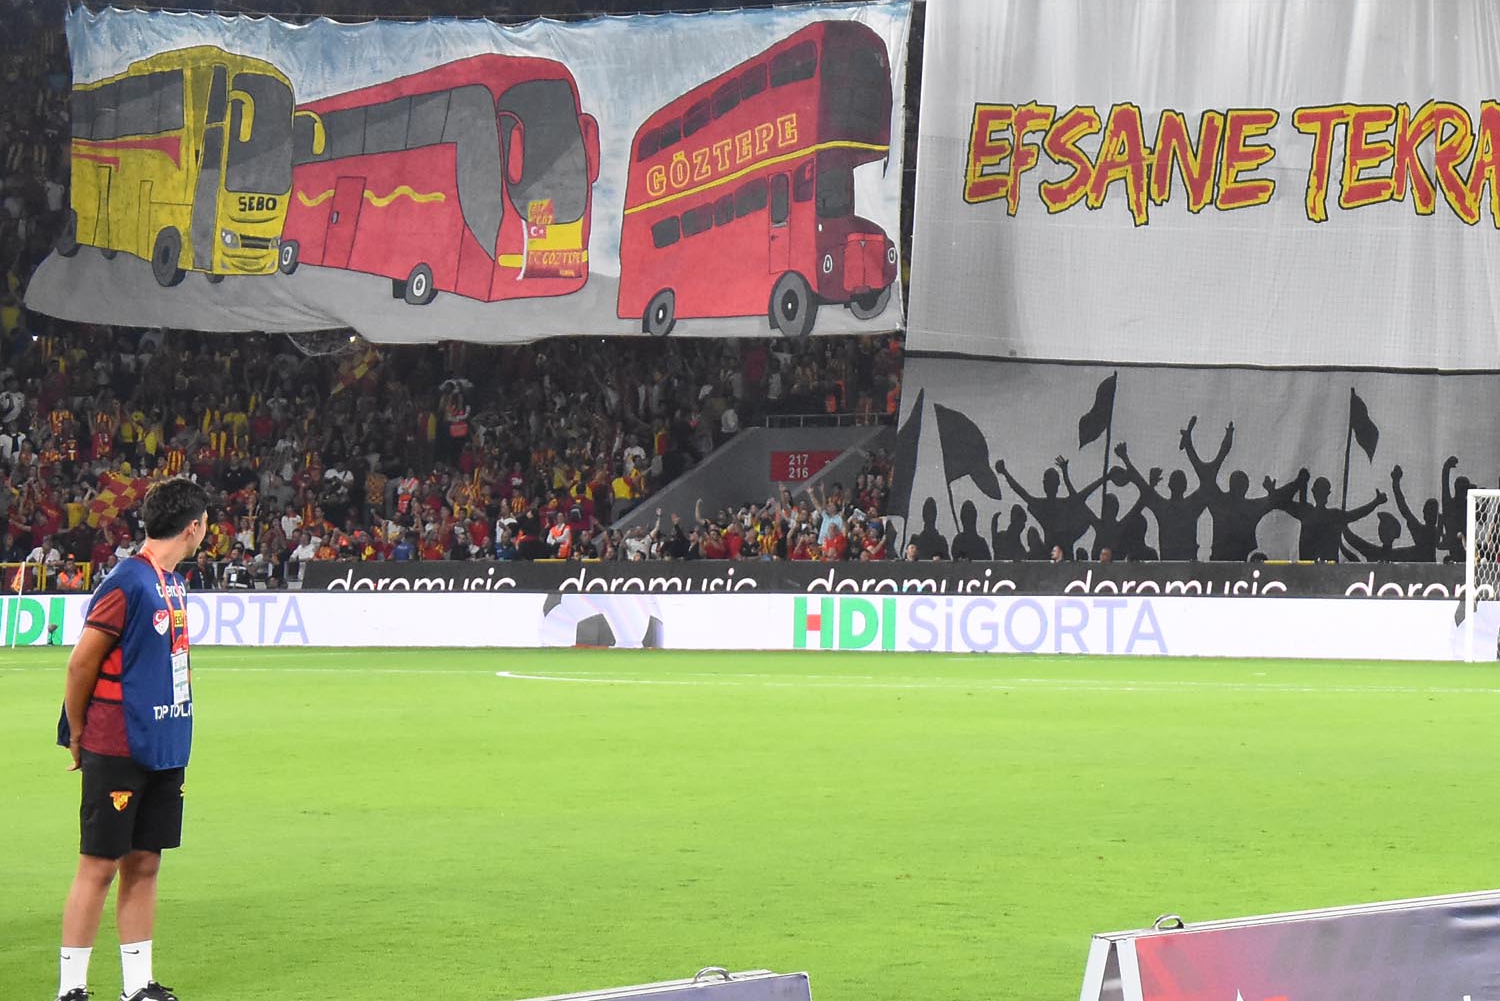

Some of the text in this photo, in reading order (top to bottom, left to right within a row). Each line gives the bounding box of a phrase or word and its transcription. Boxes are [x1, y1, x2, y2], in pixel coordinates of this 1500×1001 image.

[646, 113, 798, 196] GÖZTEPE
[962, 101, 1280, 226] EFSANE
[238, 196, 278, 212] SEBO
[789, 454, 808, 465] 217
[789, 467, 808, 478] 216
[0, 598, 64, 645] DI
[793, 597, 896, 650] HDI
